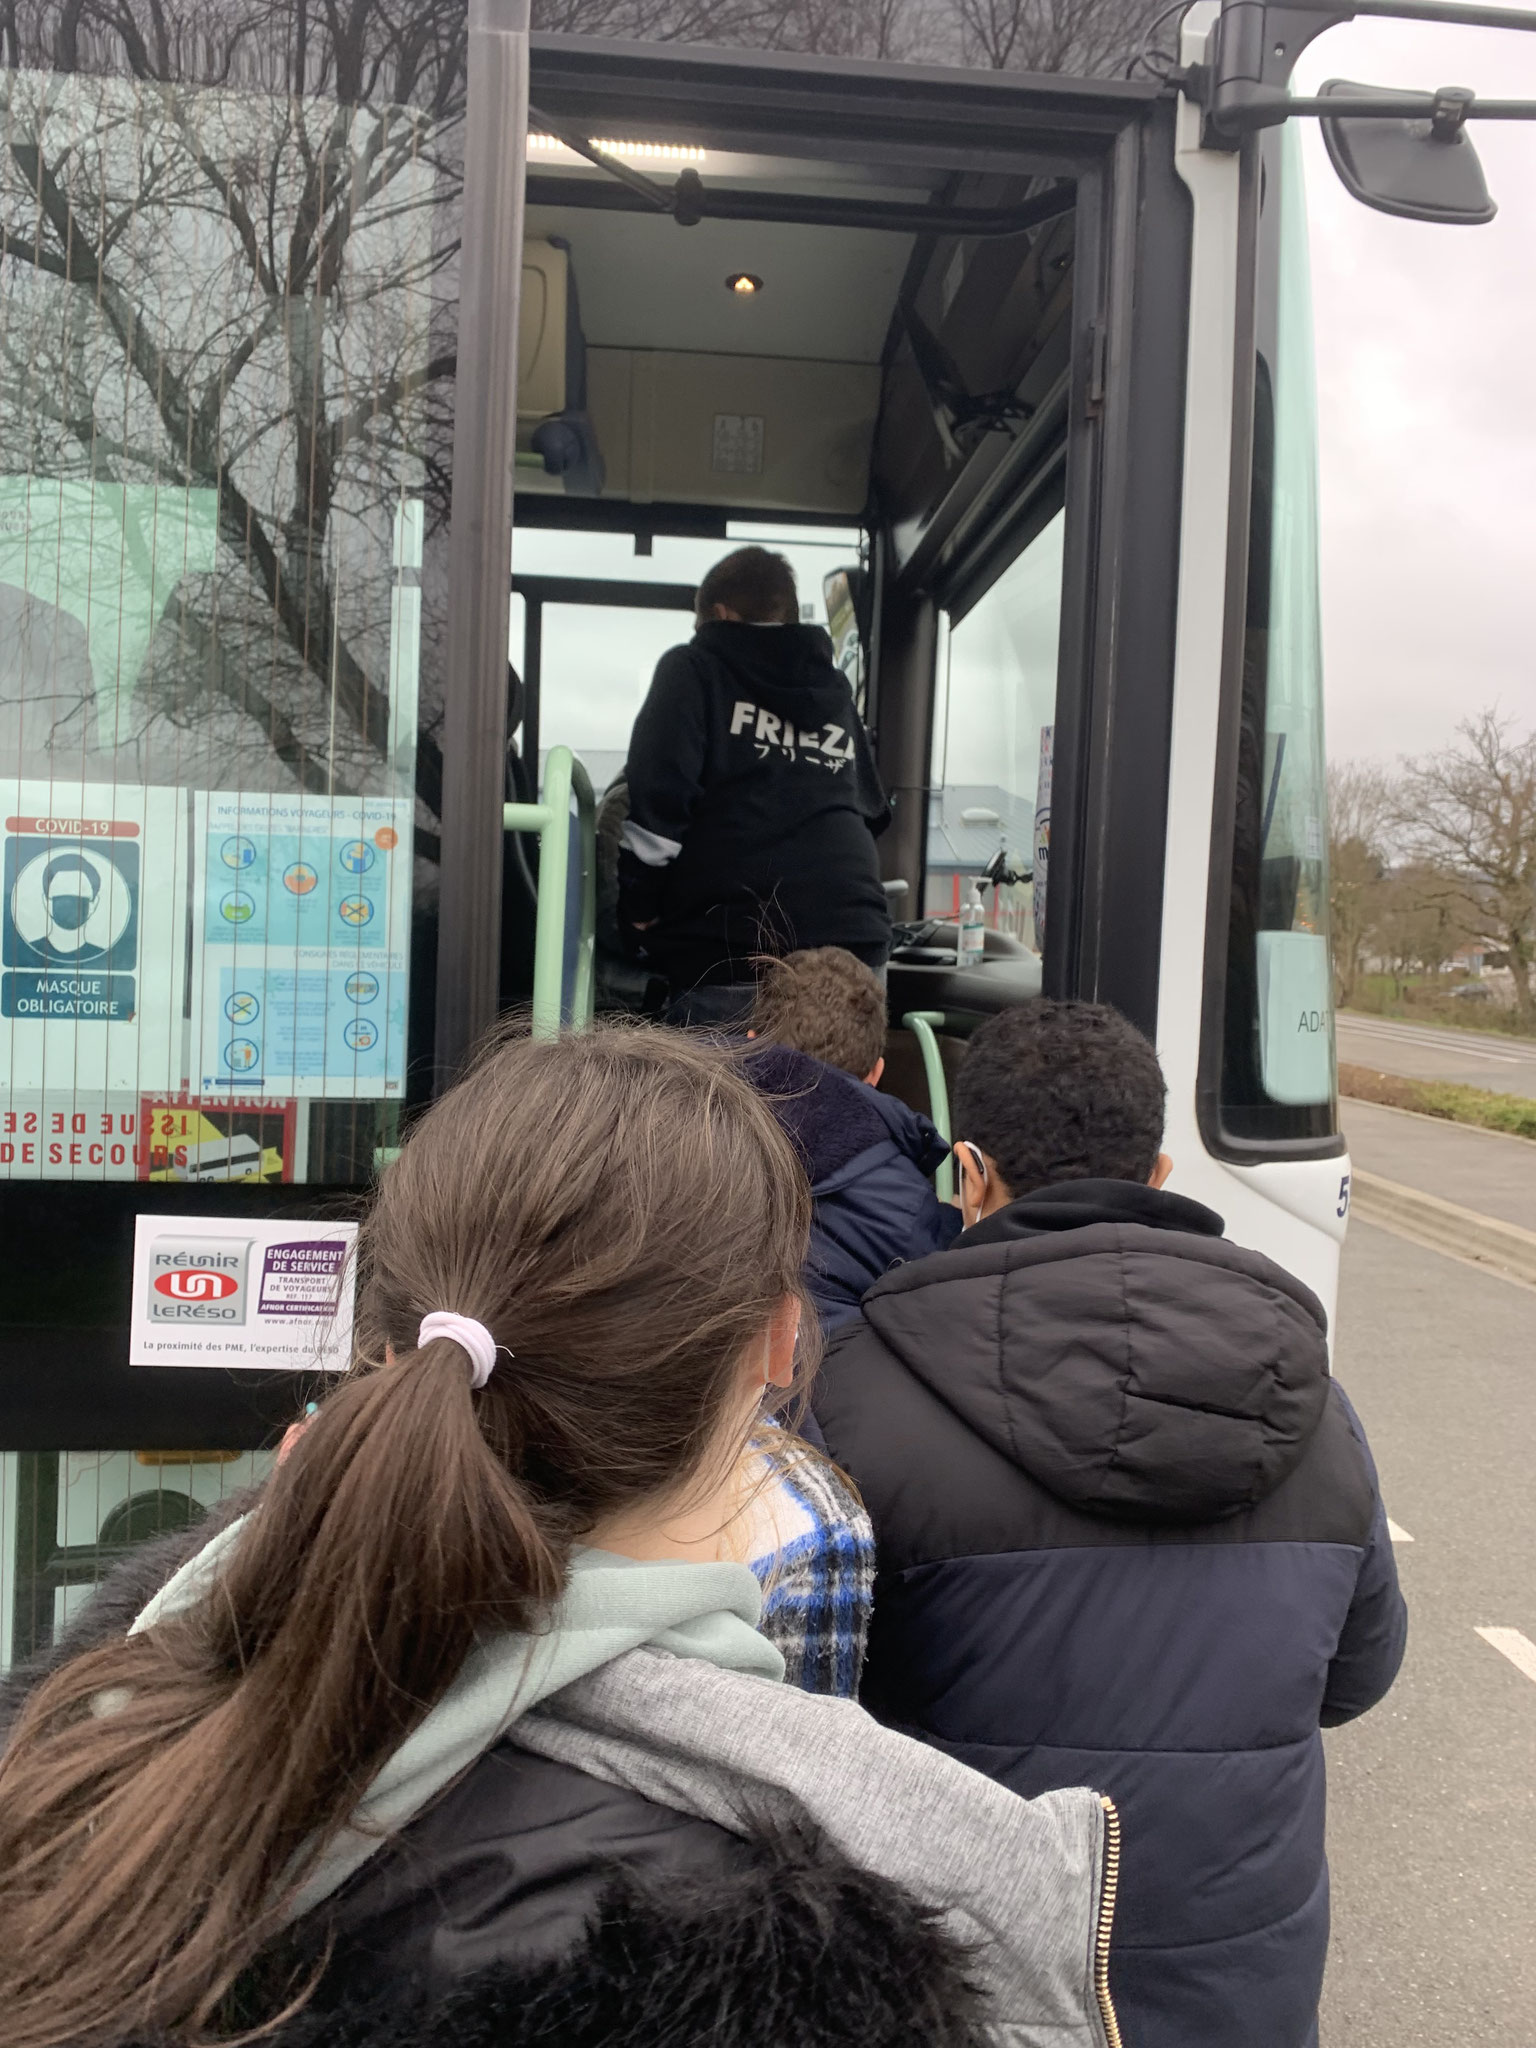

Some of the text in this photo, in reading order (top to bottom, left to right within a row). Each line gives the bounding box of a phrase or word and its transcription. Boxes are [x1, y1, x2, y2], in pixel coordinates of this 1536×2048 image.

[754, 743, 847, 774] フリーザ
[218, 806, 288, 818] INFORMATIONS
[290, 809, 345, 820] VOYAGEURS
[352, 811, 396, 821] COVID-19
[35, 819, 109, 835] COVID-19
[36, 980, 101, 996] MASQUE
[17, 998, 119, 1015] OBLIGATOIRE
[152, 1091, 287, 1109] ATTENTION
[0, 1142, 188, 1167] DE SECOURS
[267, 1249, 344, 1261] ENGAGEMENT
[272, 1261, 335, 1272] DE SERVICE
[270, 1284, 281, 1292] DE
[278, 1276, 326, 1285] TRANSPORT
[143, 1340, 154, 1349] La
[157, 1340, 203, 1351] proximité
[205, 1342, 222, 1351] des
[224, 1344, 247, 1354] PME,
[250, 1344, 299, 1355] l'expertise
[301, 1346, 314, 1354] du
